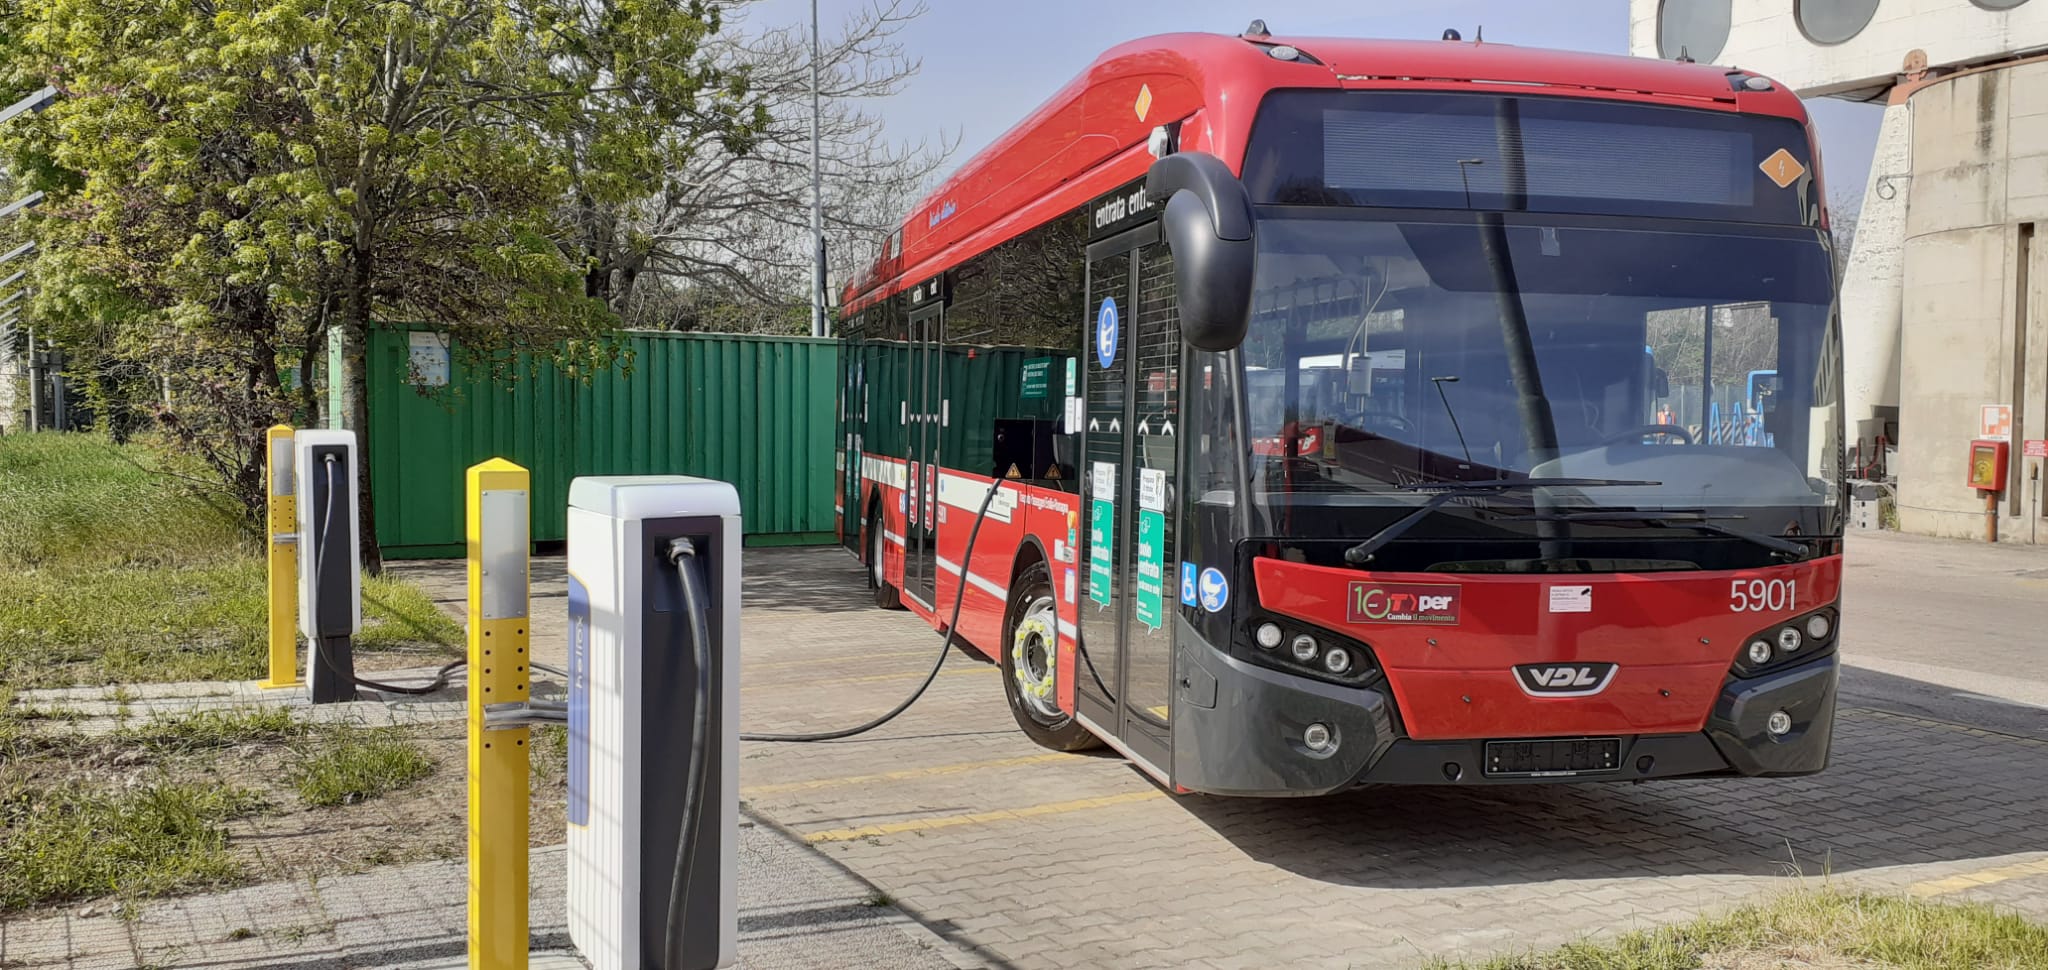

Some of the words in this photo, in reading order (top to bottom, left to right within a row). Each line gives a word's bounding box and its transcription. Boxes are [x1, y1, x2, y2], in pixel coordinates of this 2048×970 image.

[1095, 195, 1126, 229] entrata
[1128, 184, 1155, 215] entr
[1729, 578, 1797, 613] 5901
[1387, 612, 1412, 621] Cambia
[575, 614, 584, 689] heliox
[1528, 666, 1598, 688] VDL
